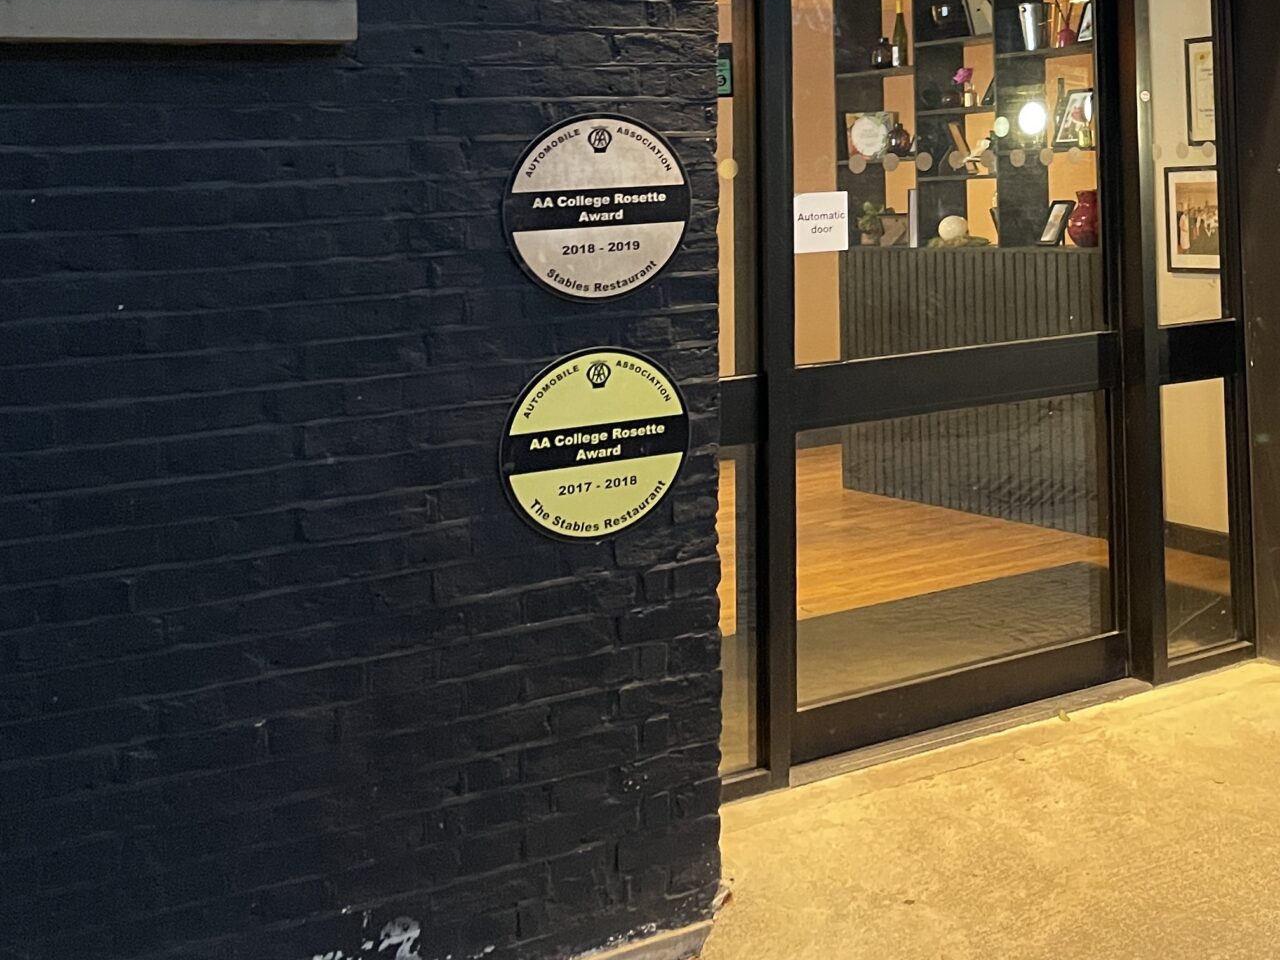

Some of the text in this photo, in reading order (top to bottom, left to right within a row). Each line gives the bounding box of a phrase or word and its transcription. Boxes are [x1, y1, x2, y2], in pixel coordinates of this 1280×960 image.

[525, 126, 672, 178] AUTOMOBILE ASSOCIATION
[532, 192, 667, 209] AA College Rosette
[578, 209, 624, 222] Award
[798, 211, 846, 221] Automatic
[811, 226, 833, 234] door
[562, 243, 595, 256] 2018
[608, 240, 641, 252] 2019
[546, 260, 658, 292] Stables Restaurant
[523, 360, 672, 419] AUTOMOBILE ASSOCIATION
[530, 423, 665, 450] AA College Rosette
[576, 445, 622, 461] Award
[558, 481, 593, 496] 2017
[605, 475, 638, 489] 2018
[530, 479, 666, 532] The Stables Restaurant
